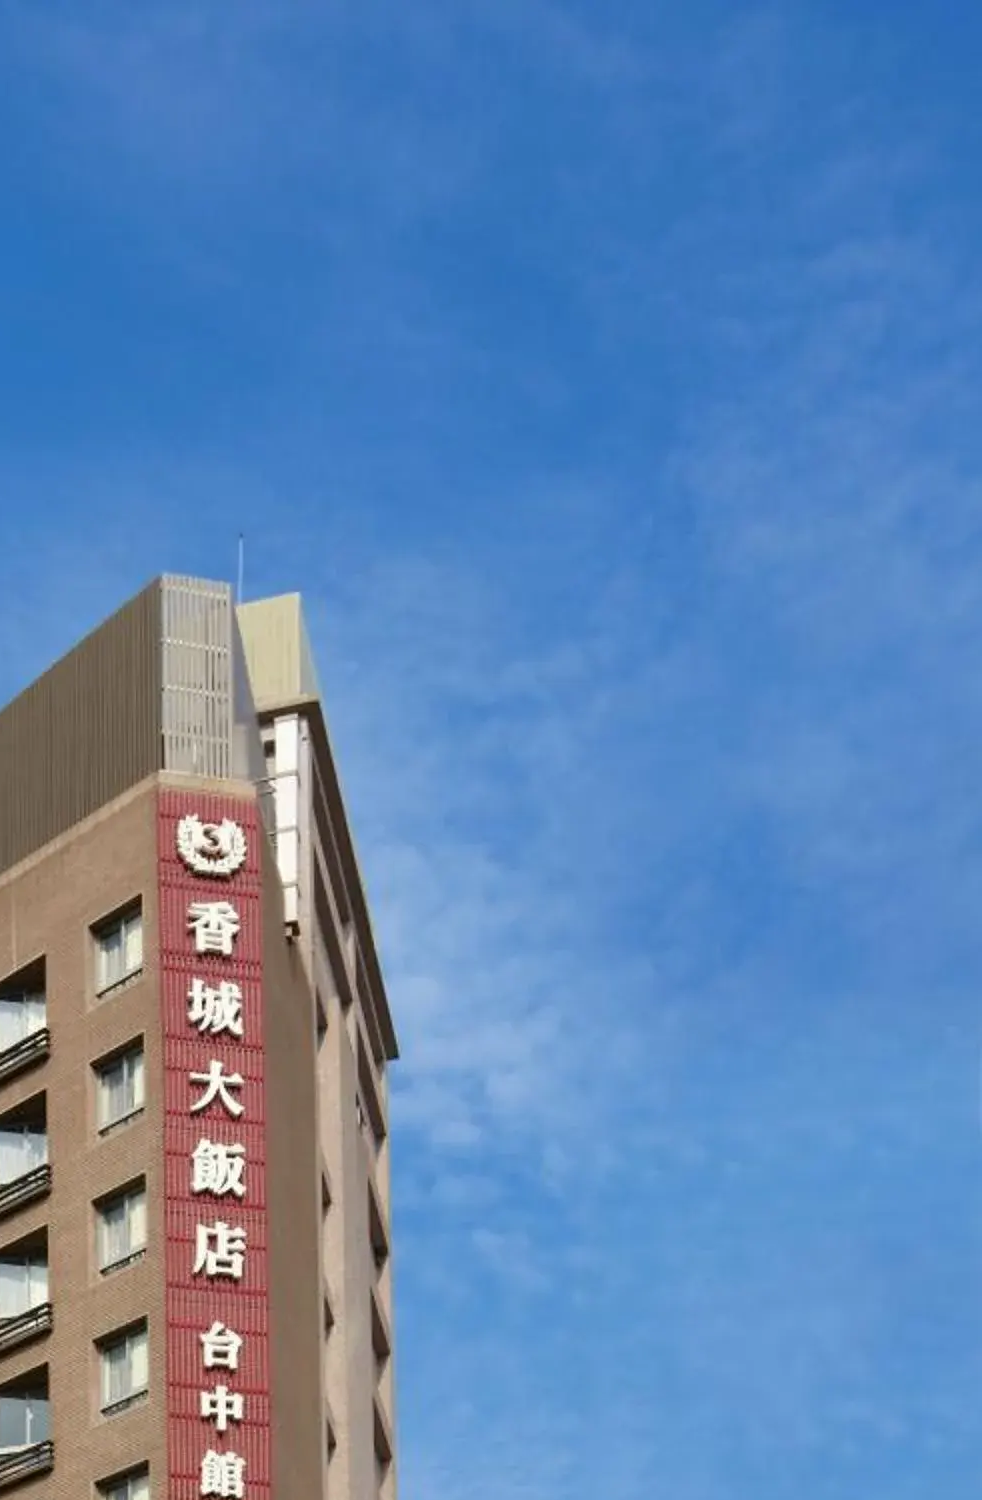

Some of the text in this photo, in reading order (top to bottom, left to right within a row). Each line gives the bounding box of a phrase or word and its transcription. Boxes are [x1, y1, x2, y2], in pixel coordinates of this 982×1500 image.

[186, 902, 247, 1499] 香城大飯店 台中館
